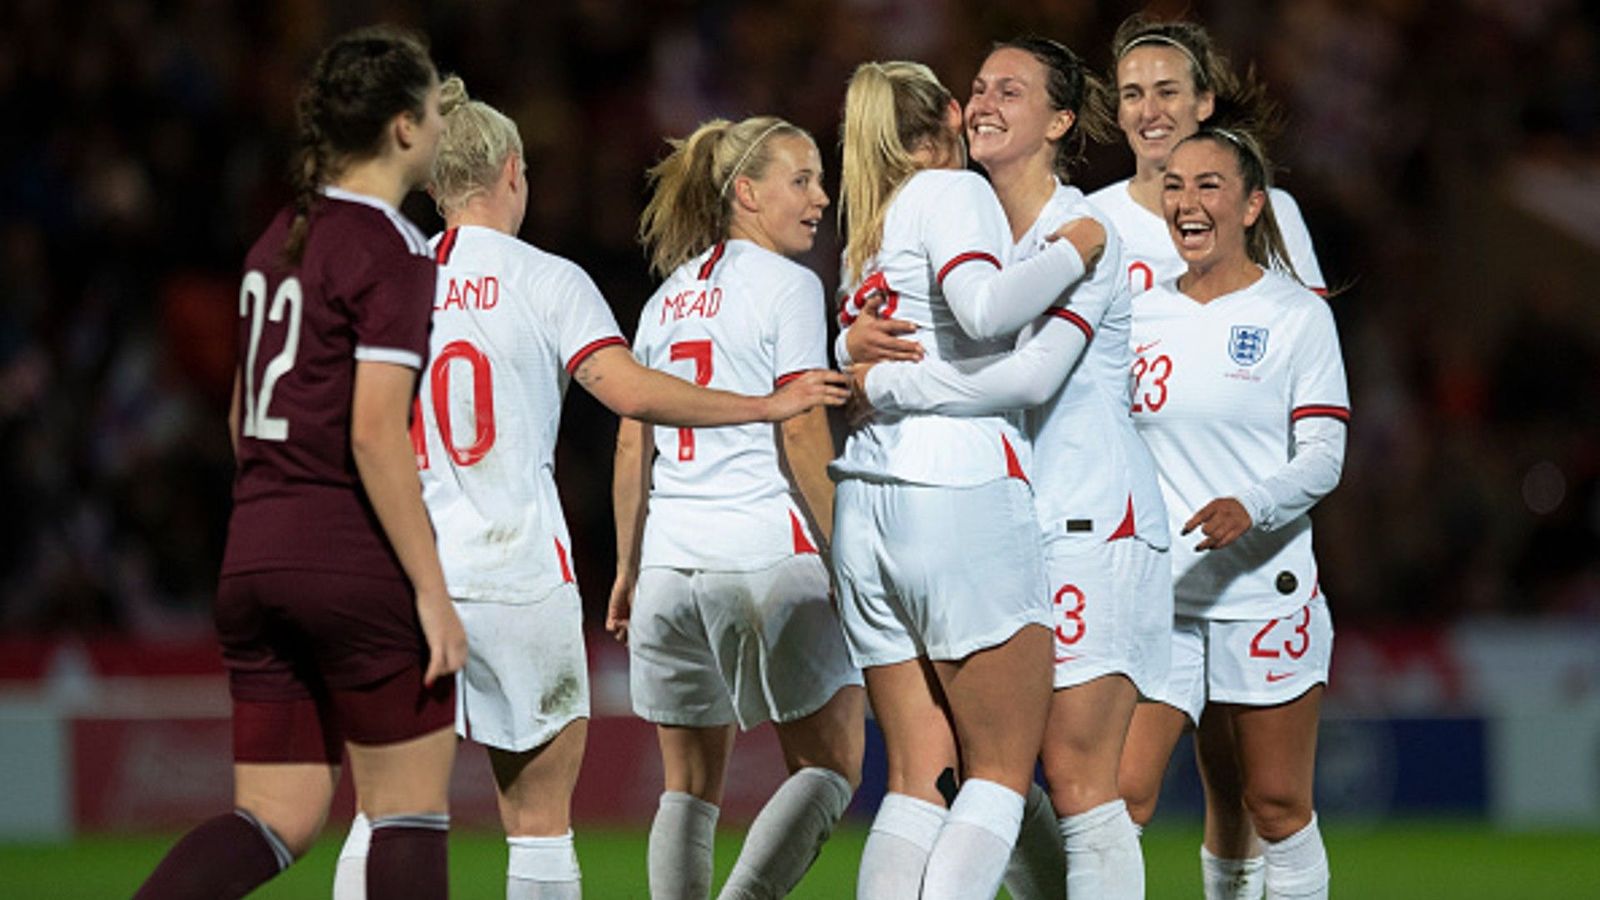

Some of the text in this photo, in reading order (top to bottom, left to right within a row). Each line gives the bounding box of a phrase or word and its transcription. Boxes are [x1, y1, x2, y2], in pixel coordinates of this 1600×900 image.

[431, 276, 498, 310] AND
[660, 287, 721, 325] MEAD
[669, 340, 713, 461] 7
[1130, 355, 1172, 412] 23
[1249, 605, 1310, 659] 23
